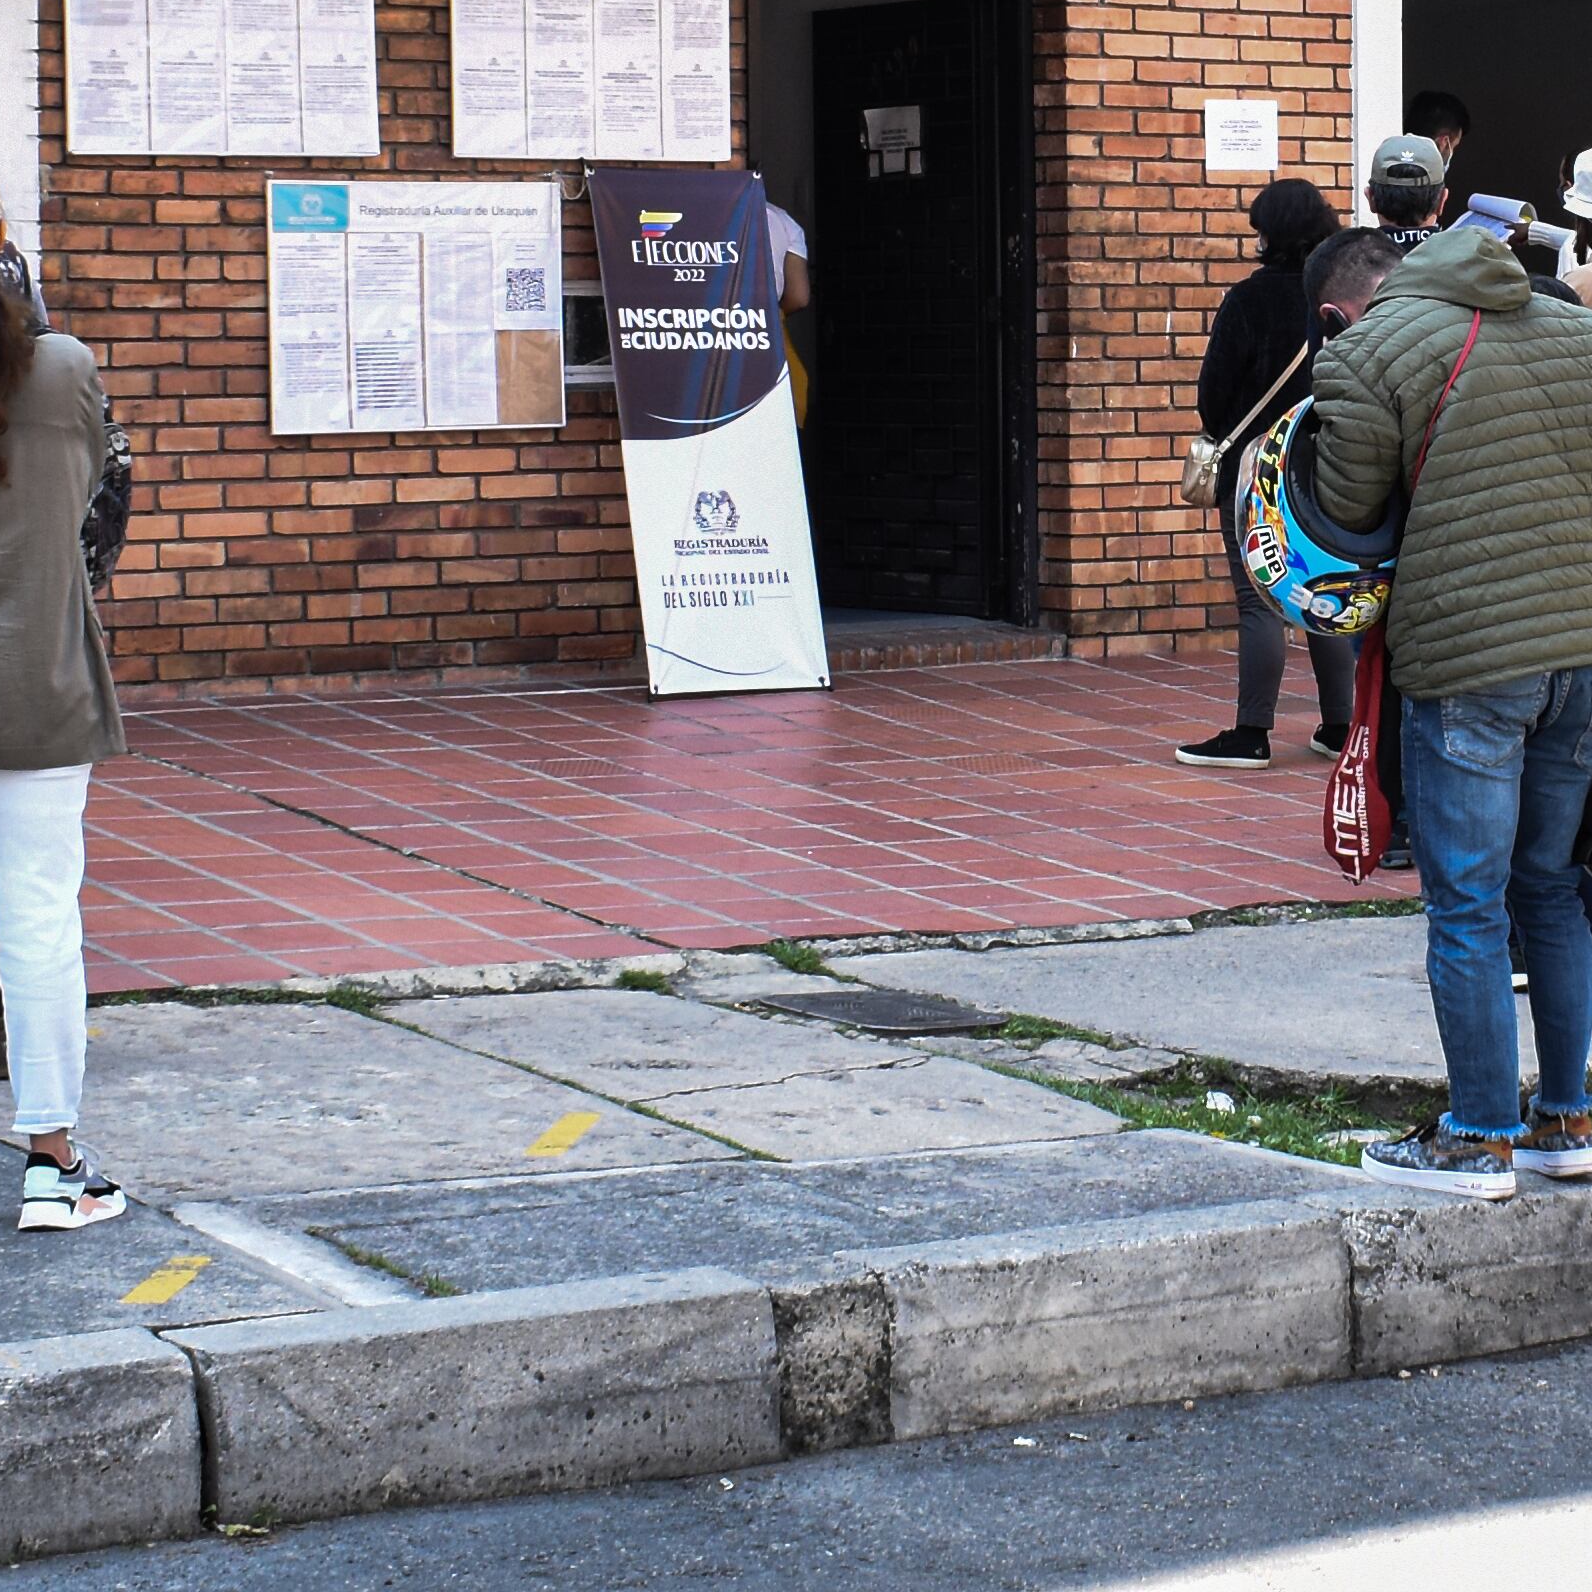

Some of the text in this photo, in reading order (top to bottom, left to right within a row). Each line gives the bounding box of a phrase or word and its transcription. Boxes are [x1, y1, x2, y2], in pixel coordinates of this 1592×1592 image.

[474, 205, 488, 216] de
[630, 237, 739, 266] ELECCIONES
[673, 268, 707, 282] 2022
[617, 302, 767, 330] INSCRIPCIÓN
[630, 331, 771, 350] CIUDADANOS
[673, 535, 769, 550] REGISTRADURÍA
[661, 568, 790, 587] LA REGISTRADURÍA
[663, 589, 755, 609] DEL SIGLO XXI
